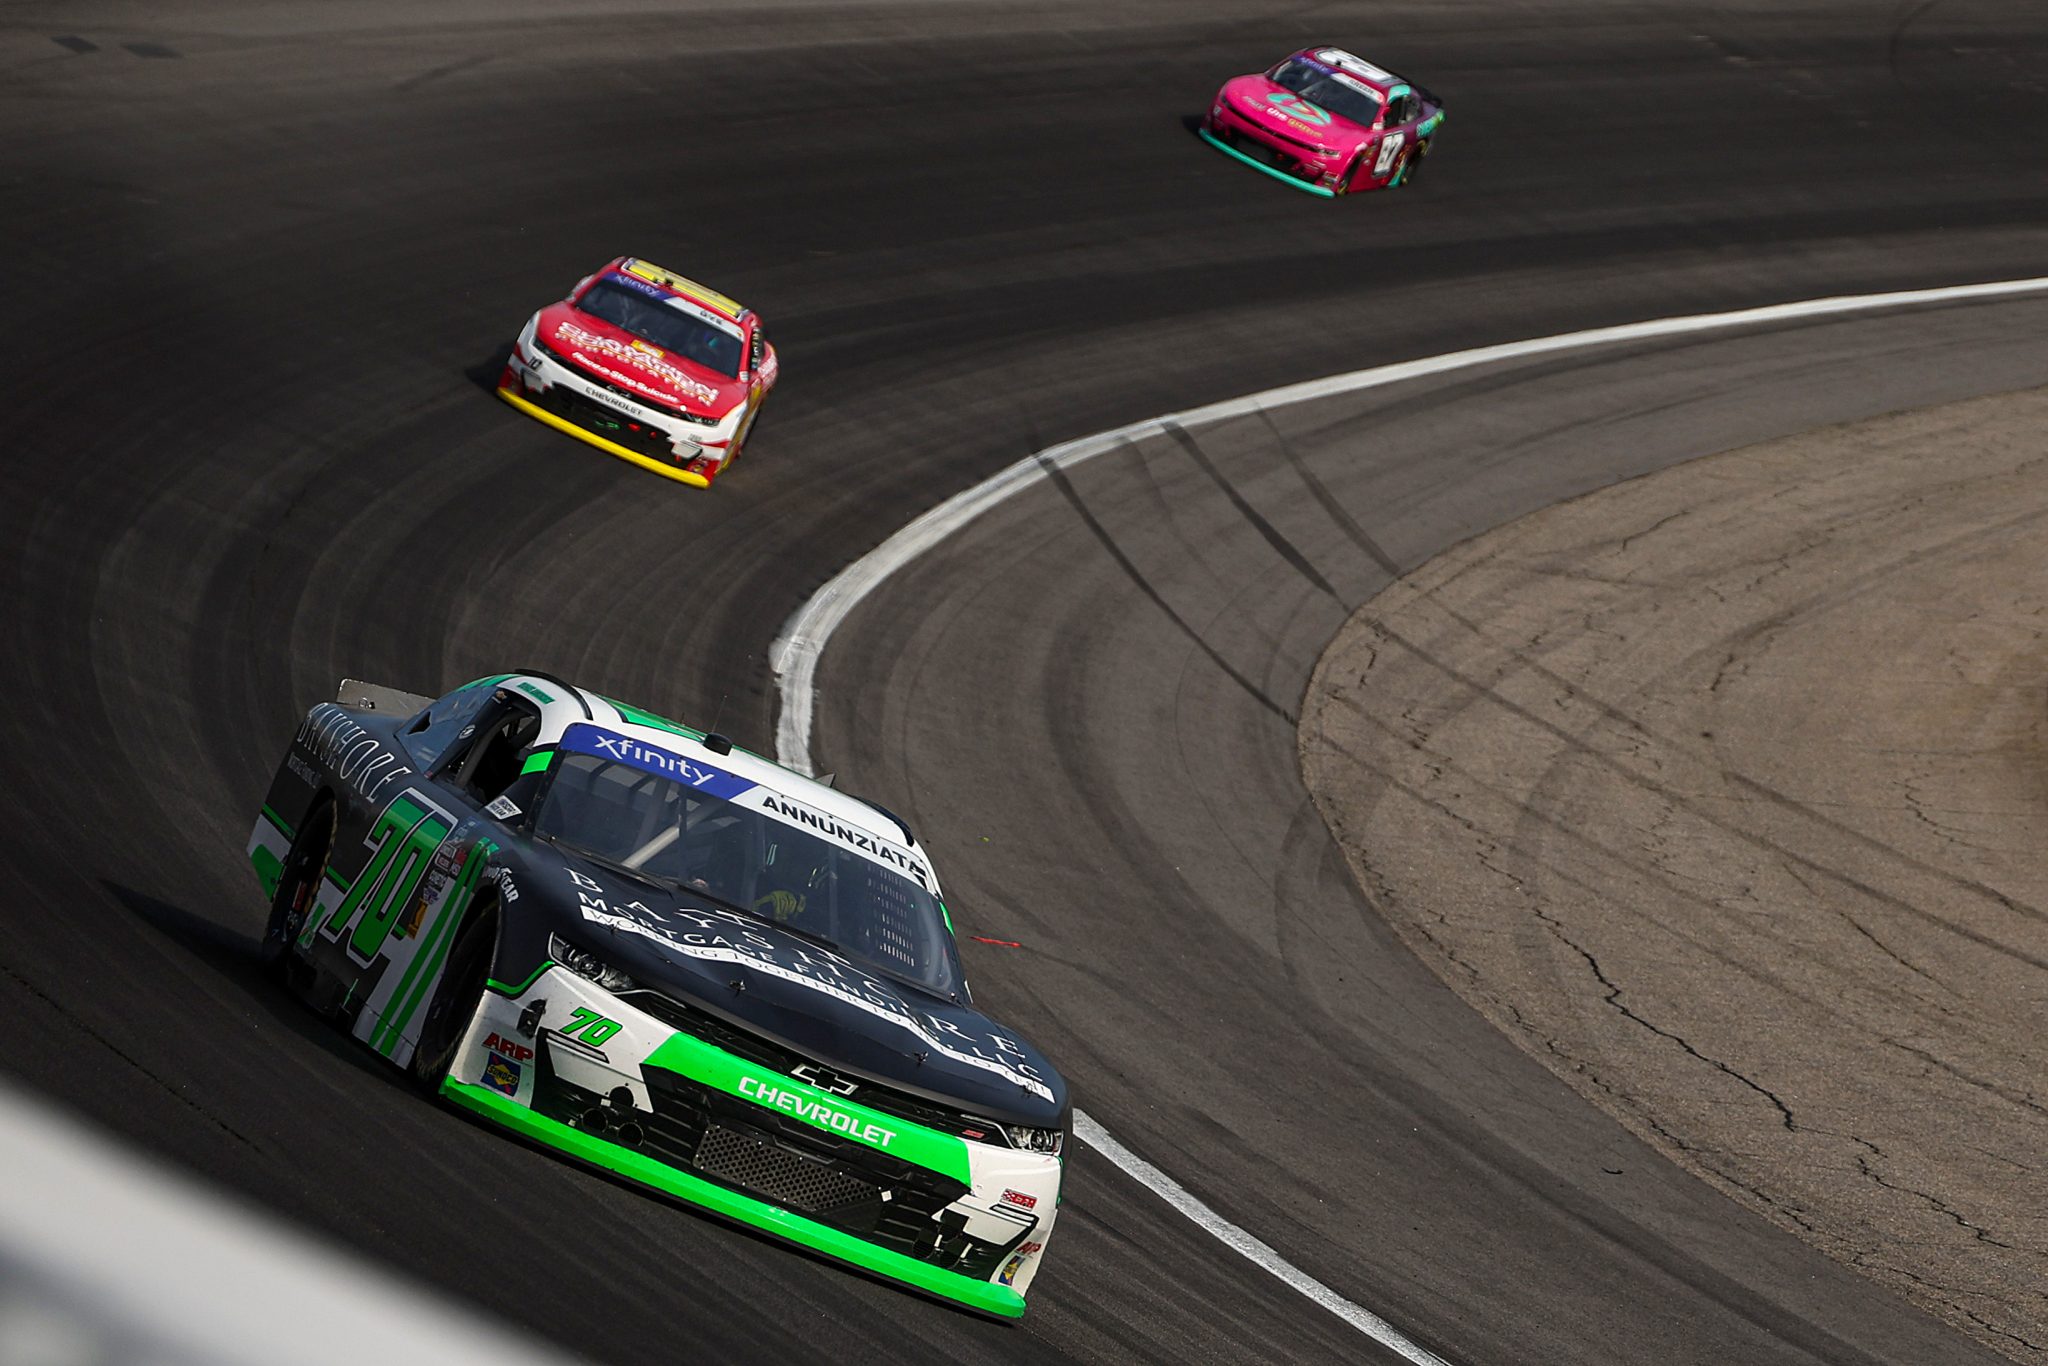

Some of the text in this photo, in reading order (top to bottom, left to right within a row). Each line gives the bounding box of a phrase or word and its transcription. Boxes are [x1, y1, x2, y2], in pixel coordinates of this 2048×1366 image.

[585, 386, 642, 416] CHEVROLET
[609, 370, 637, 387] Stop
[297, 702, 412, 803] BAYSHORE
[594, 735, 714, 786] xfinity
[316, 787, 459, 964] 70
[577, 891, 777, 964] MORTGAGE
[971, 1046, 1043, 1082] LLC
[481, 1031, 534, 1062] ARP
[558, 1006, 623, 1047] 70
[738, 1075, 897, 1147] CHEVROLET
